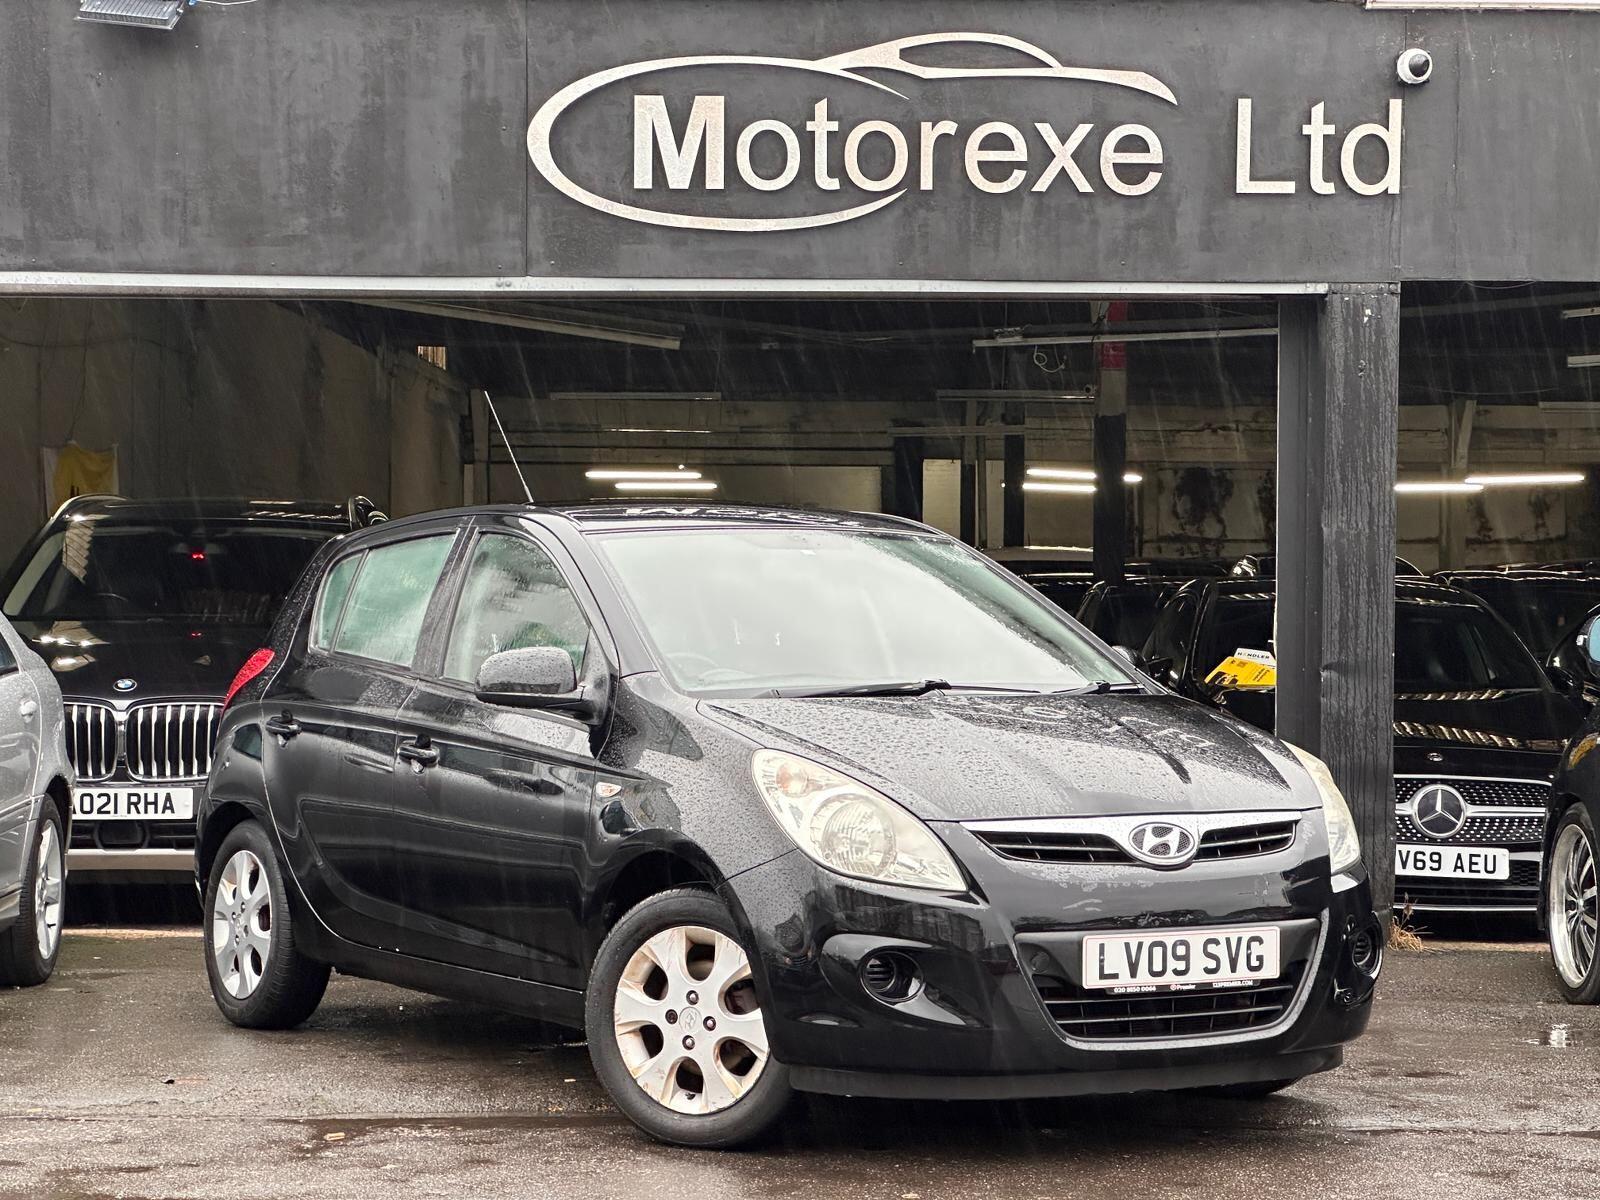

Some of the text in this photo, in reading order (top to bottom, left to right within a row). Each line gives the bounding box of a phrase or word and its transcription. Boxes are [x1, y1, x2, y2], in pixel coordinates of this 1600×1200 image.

[634, 95, 1402, 196] Motorexe Ltd
[126, 792, 175, 815] RHA
[1453, 852, 1497, 875] AEU
[1099, 935, 1265, 981] LV09 SVG
